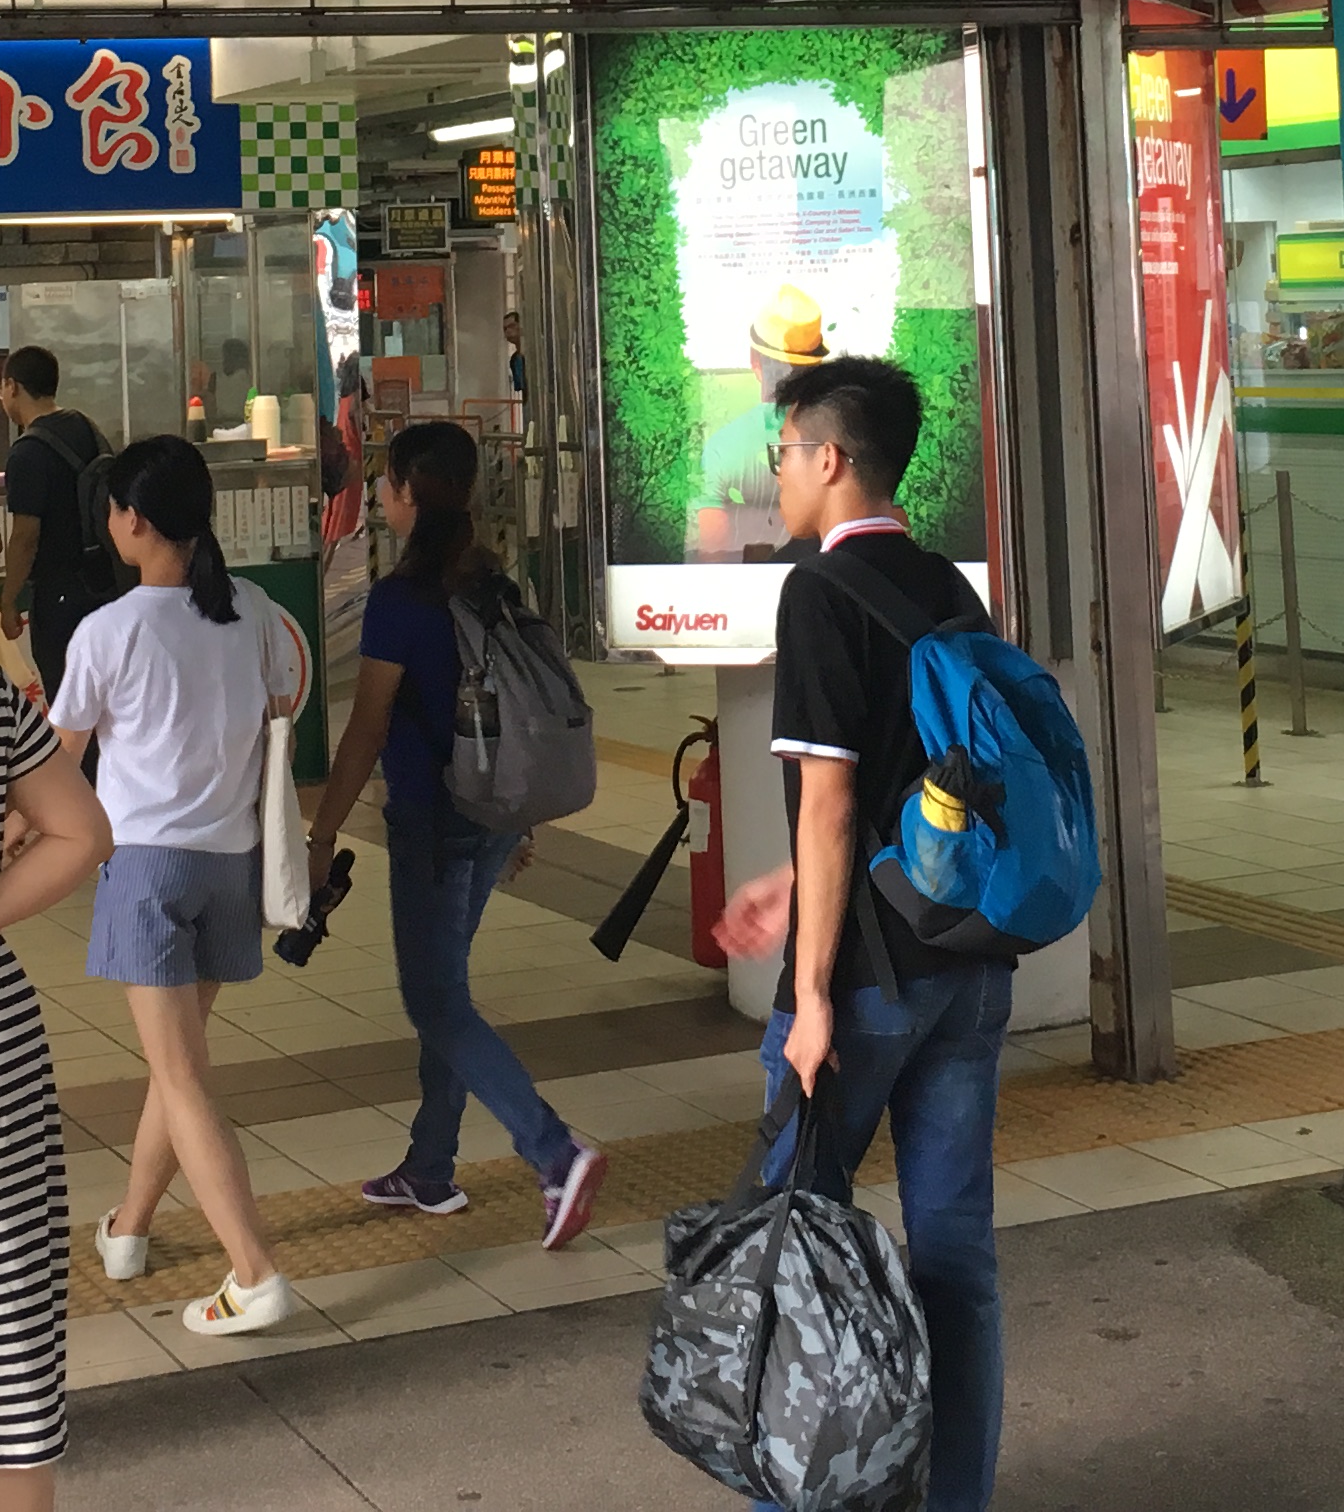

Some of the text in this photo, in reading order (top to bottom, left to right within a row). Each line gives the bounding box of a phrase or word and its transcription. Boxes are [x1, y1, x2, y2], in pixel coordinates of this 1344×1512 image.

[739, 114, 827, 147] Green
[720, 150, 848, 190] getaway
[635, 604, 728, 635] Saiyuen
